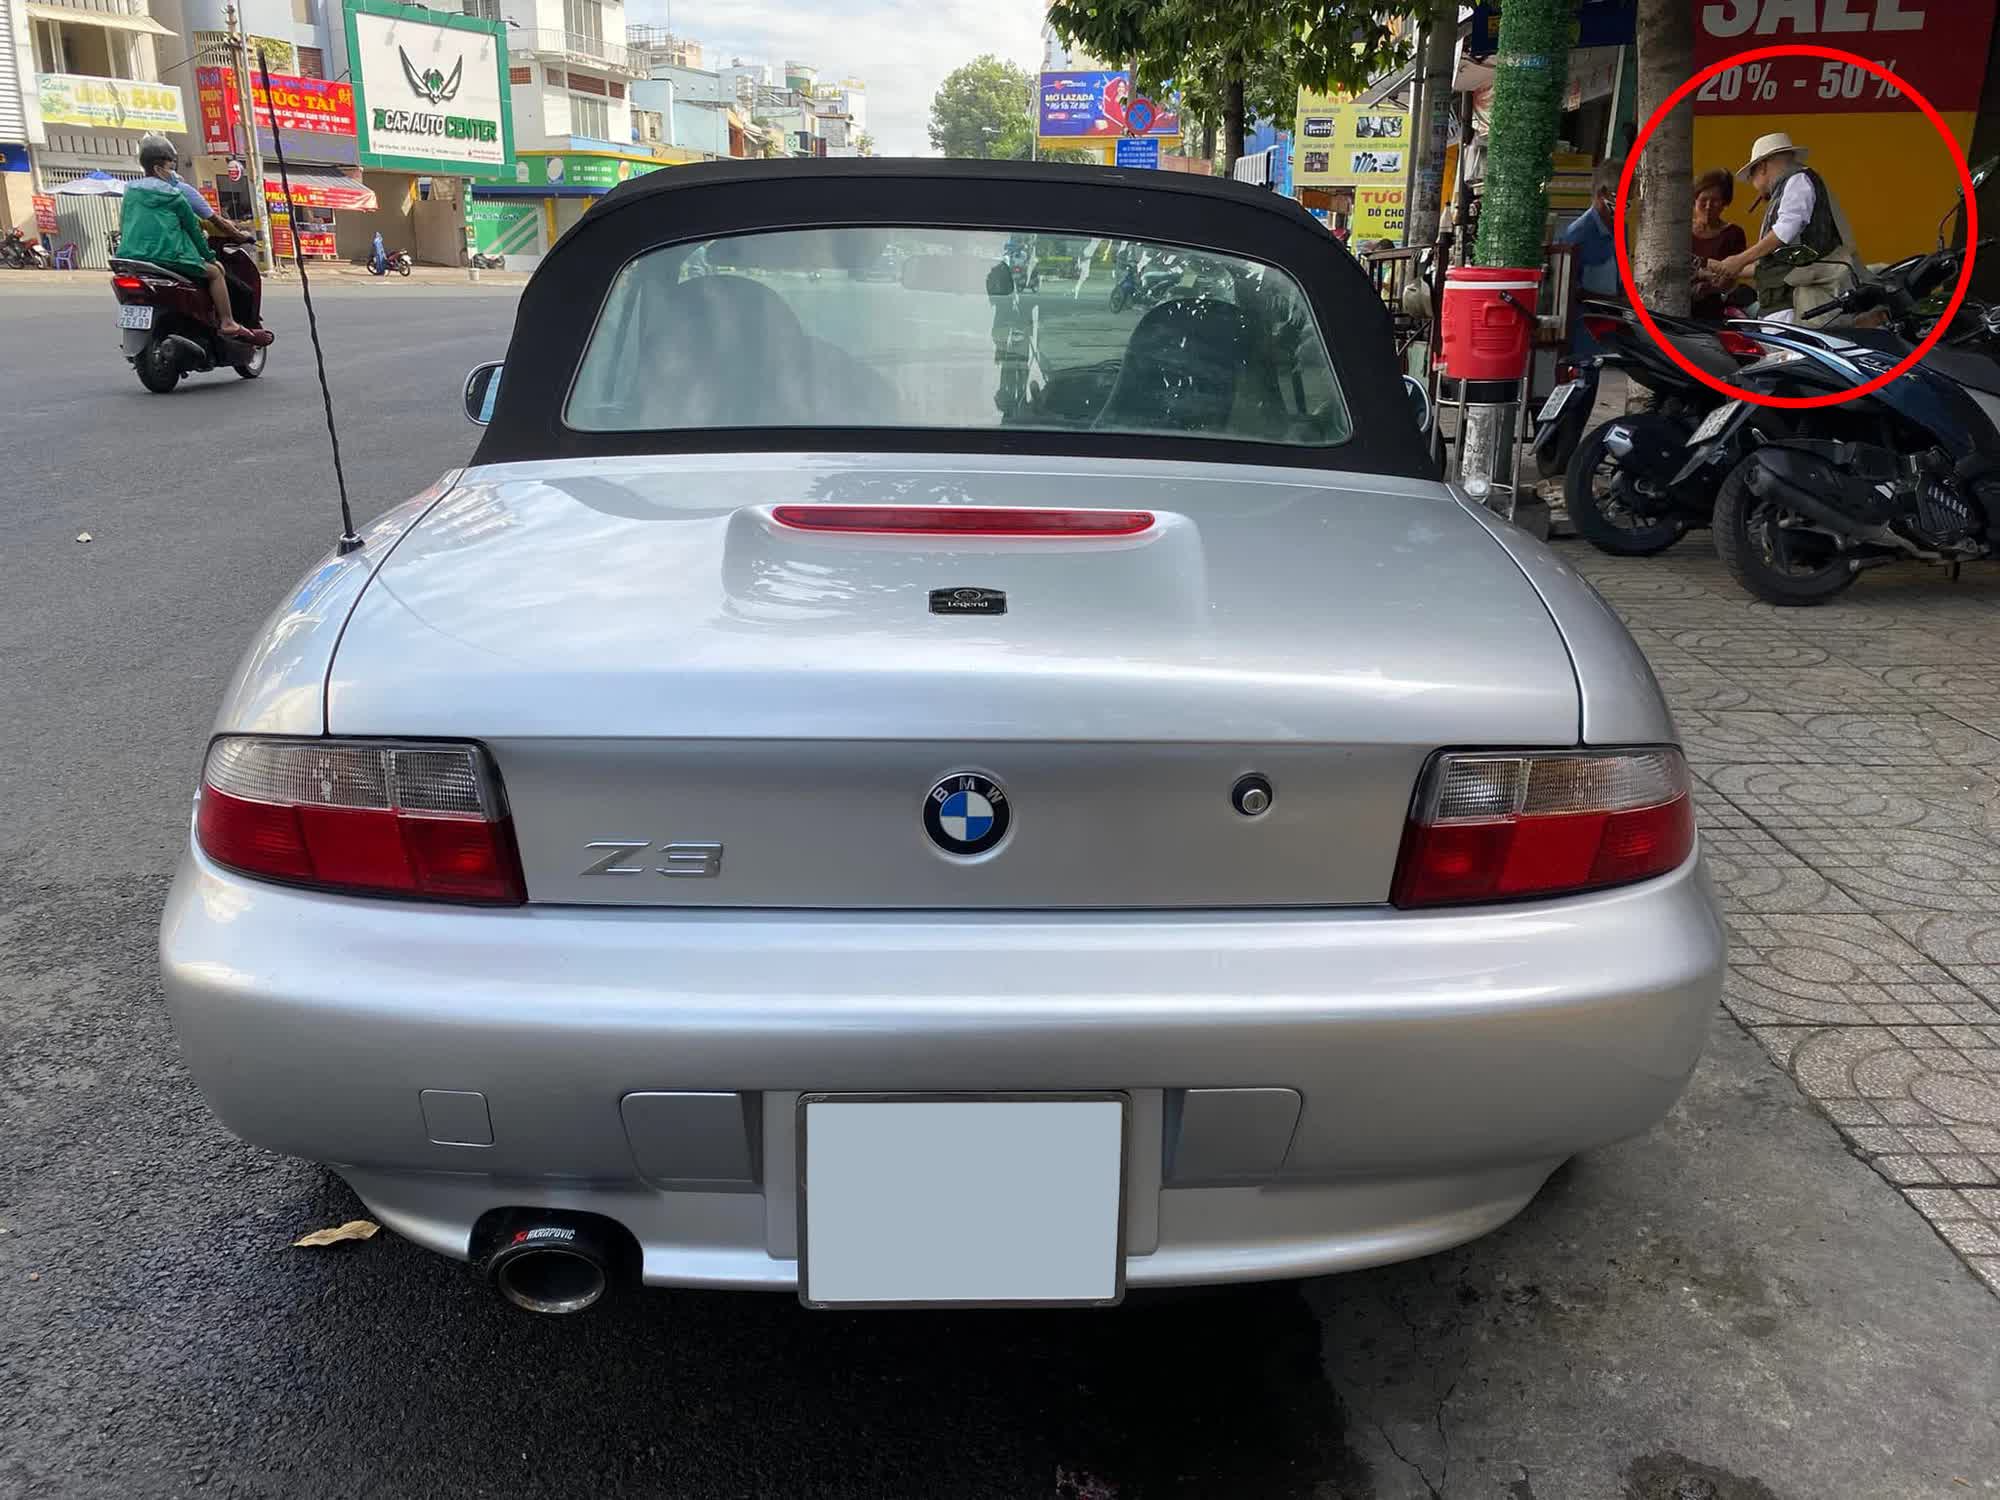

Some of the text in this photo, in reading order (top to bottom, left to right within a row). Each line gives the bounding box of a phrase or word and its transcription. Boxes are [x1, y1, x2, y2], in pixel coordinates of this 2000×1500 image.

[1696, 63, 1777, 102] 20%
[1818, 59, 1901, 99] 50%
[445, 116, 498, 142] CENTER
[947, 601, 989, 609] Legend
[931, 776, 1004, 804] BMW
[579, 841, 724, 879] Z3
